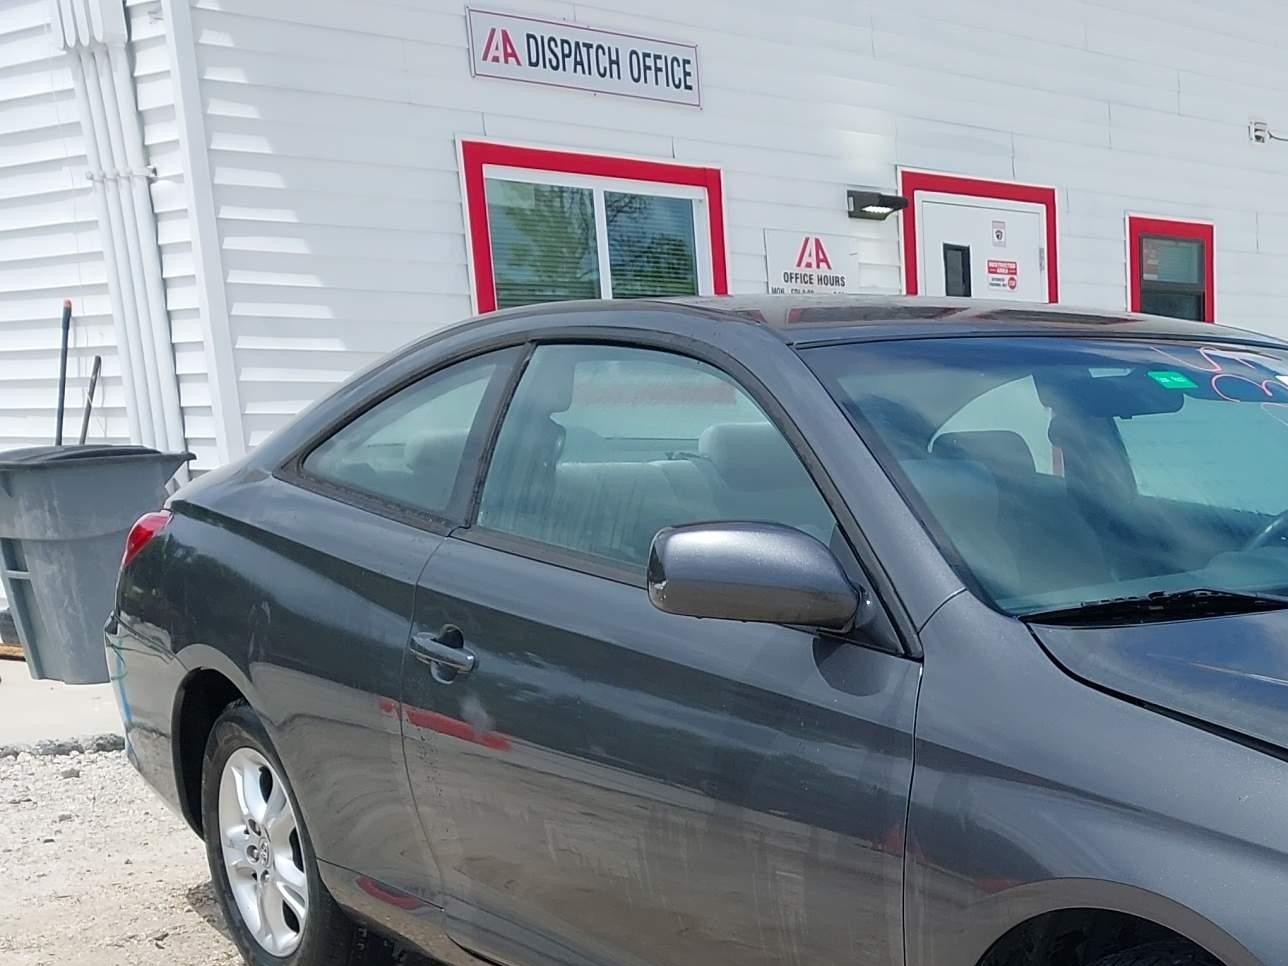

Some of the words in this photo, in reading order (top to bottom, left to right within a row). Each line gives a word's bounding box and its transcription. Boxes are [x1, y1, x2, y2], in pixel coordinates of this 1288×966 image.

[526, 33, 621, 80] DISPATCH
[628, 50, 693, 90] OFFICE
[783, 272, 814, 284] OFFICE
[817, 274, 846, 287] HOURS
